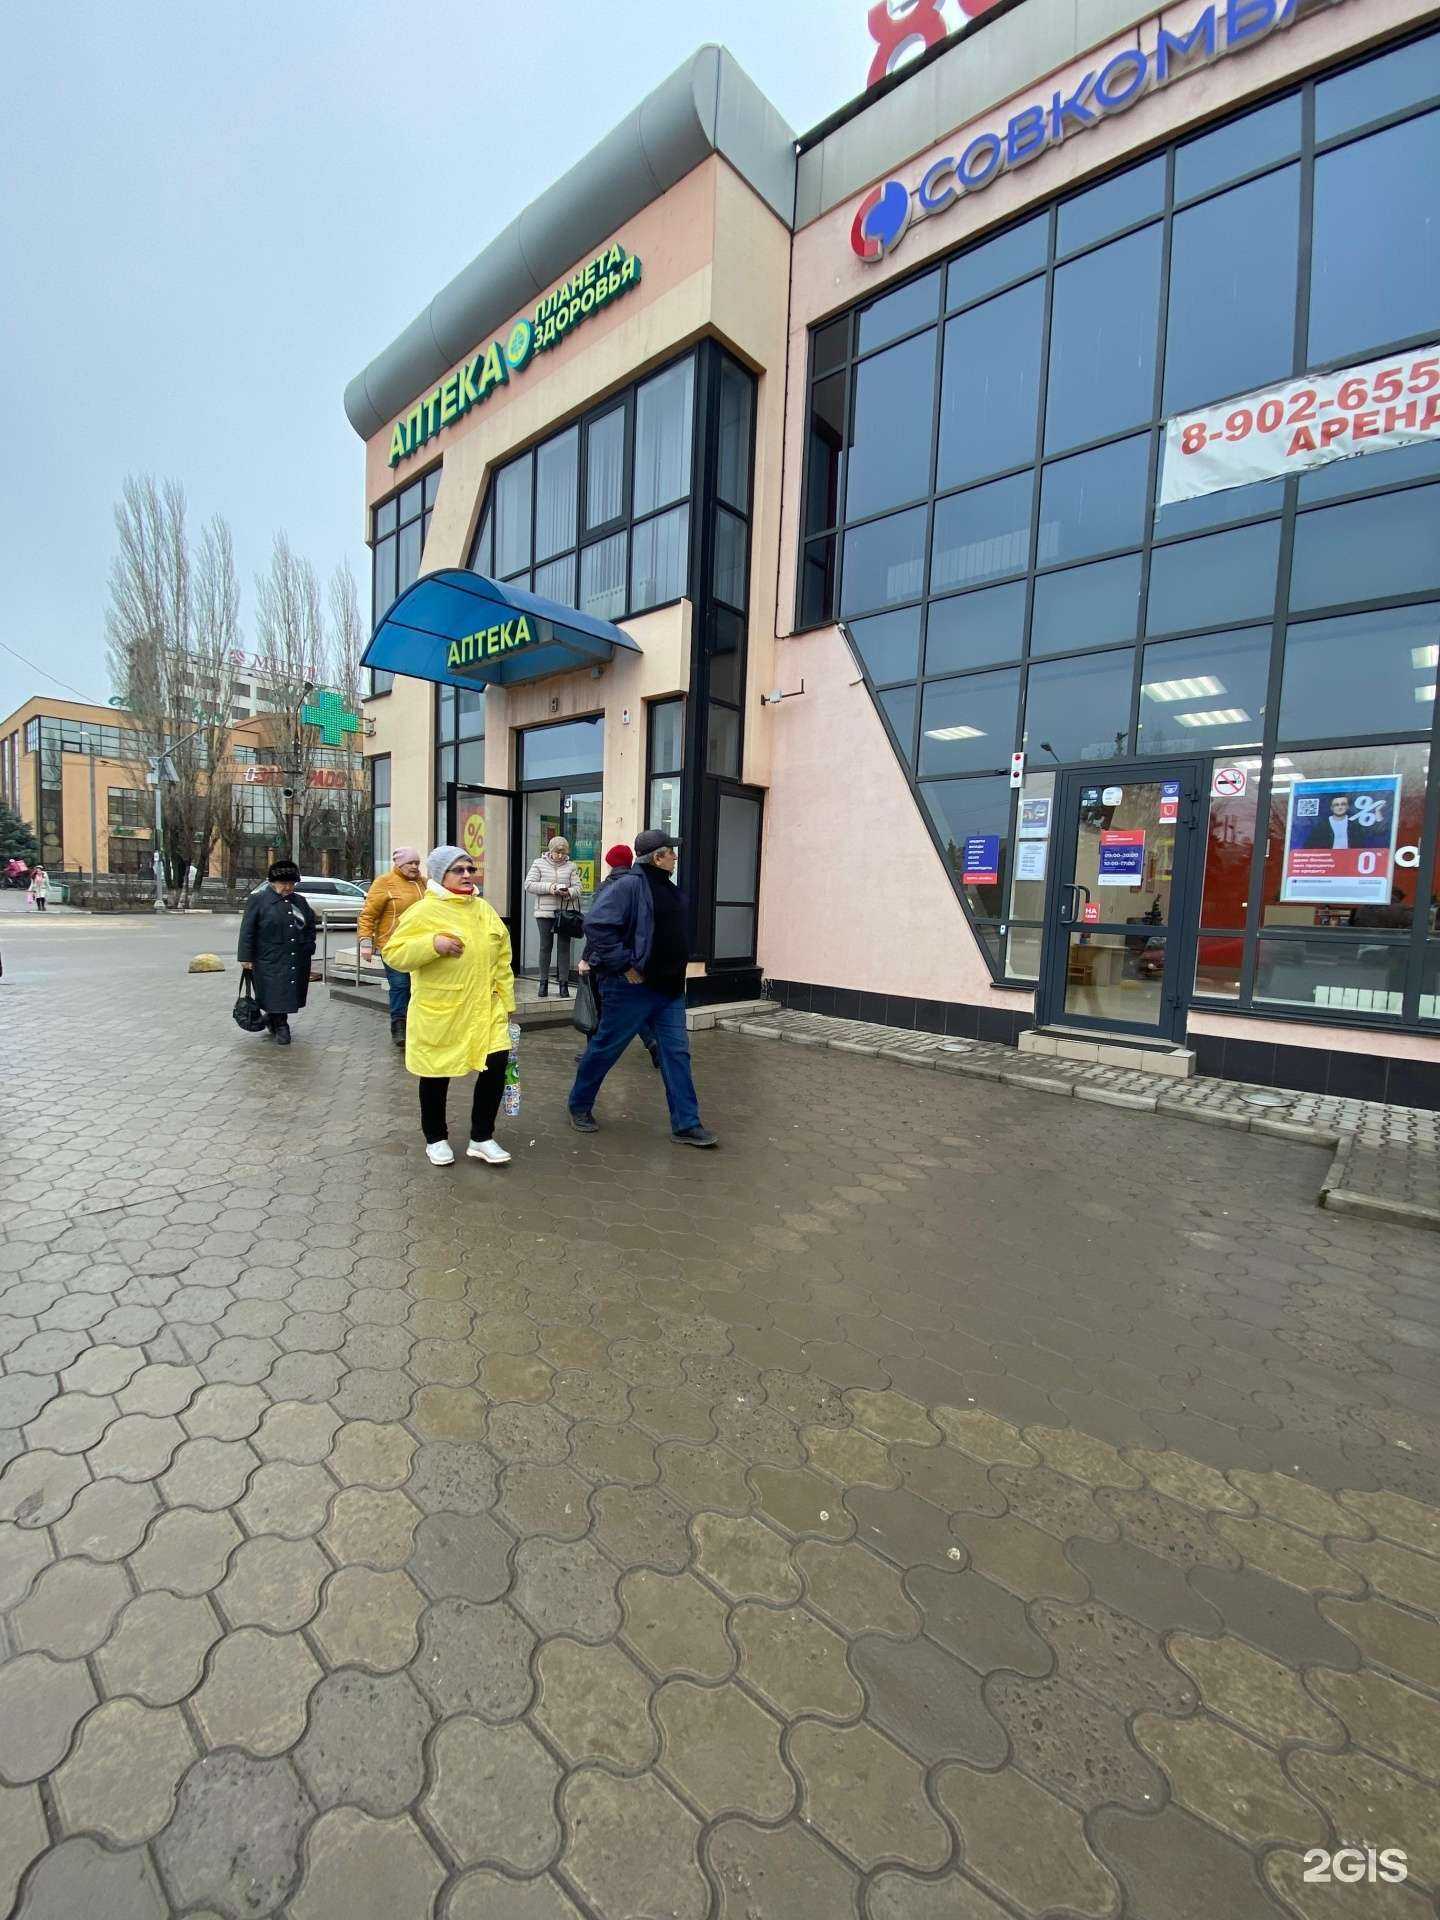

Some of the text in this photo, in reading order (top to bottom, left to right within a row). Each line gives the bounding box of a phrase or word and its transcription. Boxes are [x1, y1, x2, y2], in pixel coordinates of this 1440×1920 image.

[533, 256, 641, 348] ЗДОРОВЬЯ
[534, 242, 626, 325] ПЛАНЕТА
[387, 341, 508, 468] АПТЕКА
[447, 615, 531, 668] АПТЕКА
